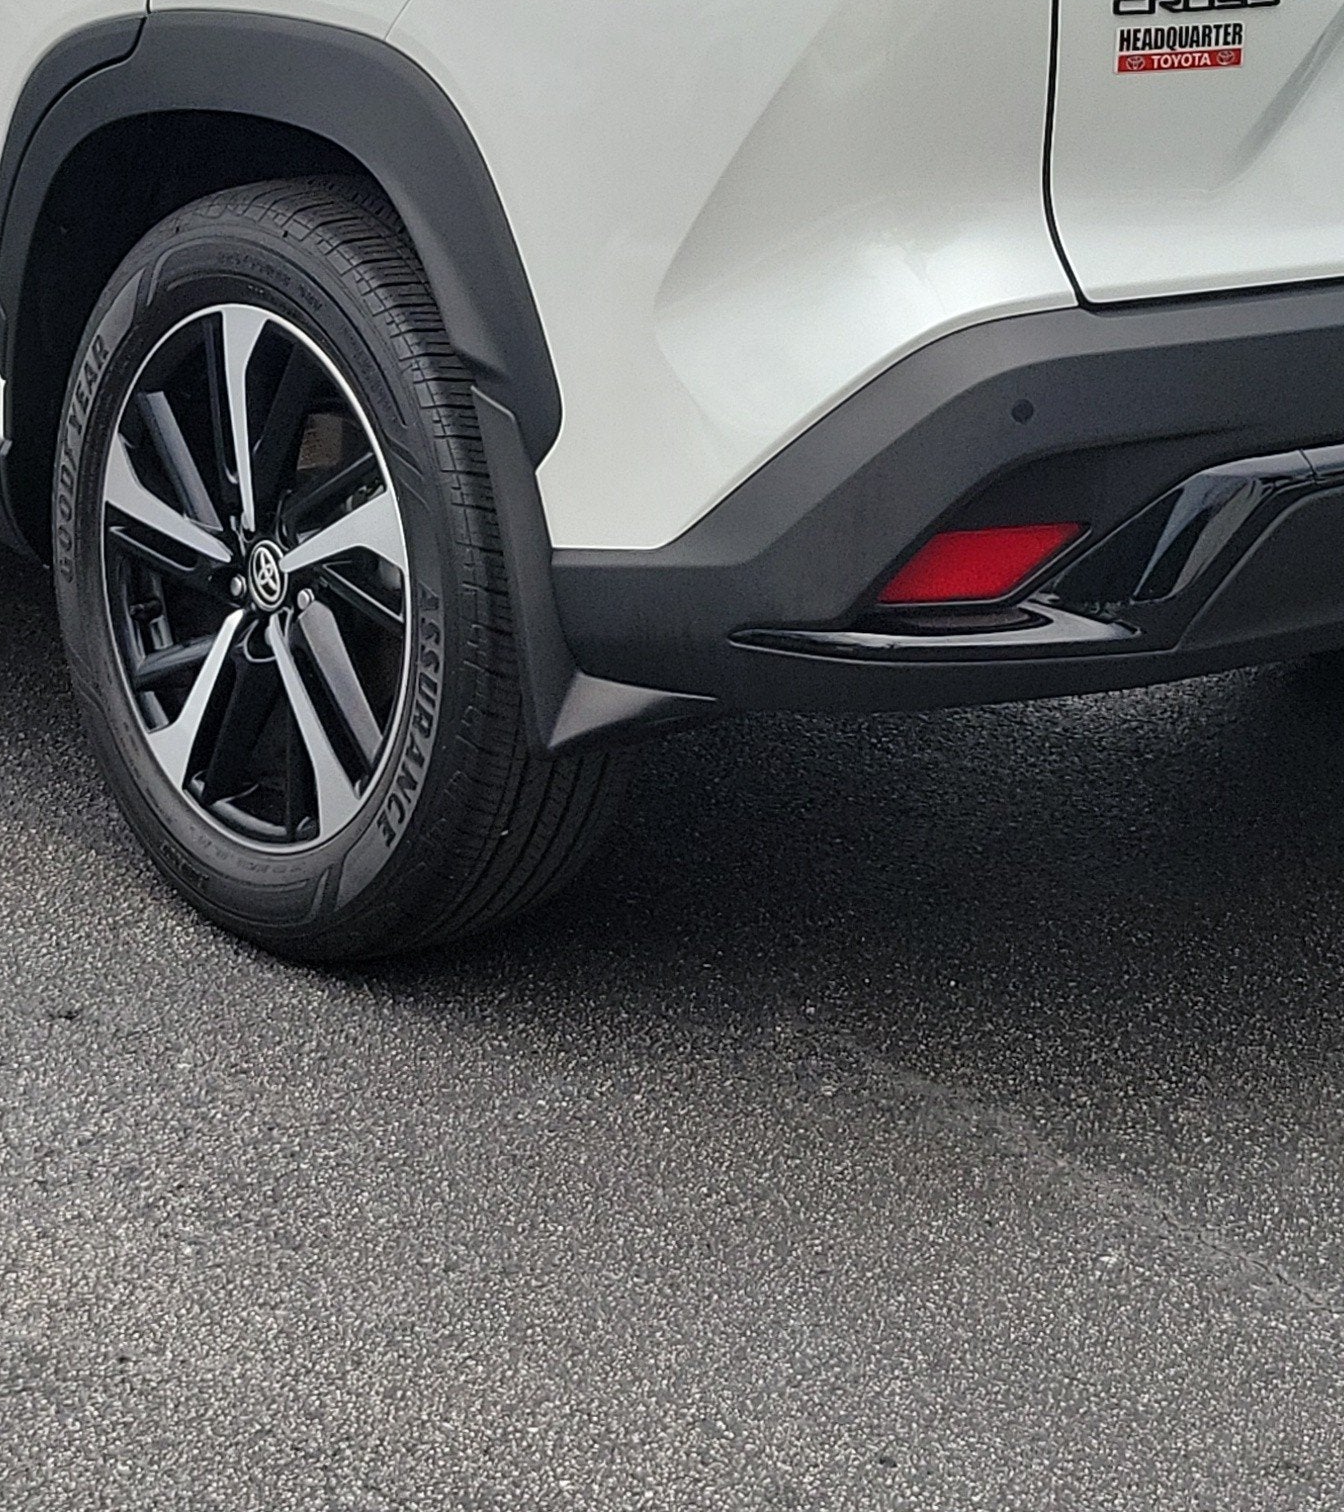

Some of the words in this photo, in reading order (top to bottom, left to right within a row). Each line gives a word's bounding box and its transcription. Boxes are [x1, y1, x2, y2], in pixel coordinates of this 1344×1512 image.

[1118, 22, 1244, 52] HEADQUARTER
[1150, 52, 1212, 70] TOYOTA
[59, 334, 109, 584] GOODYEAR
[377, 582, 440, 848] ASSURANCE
